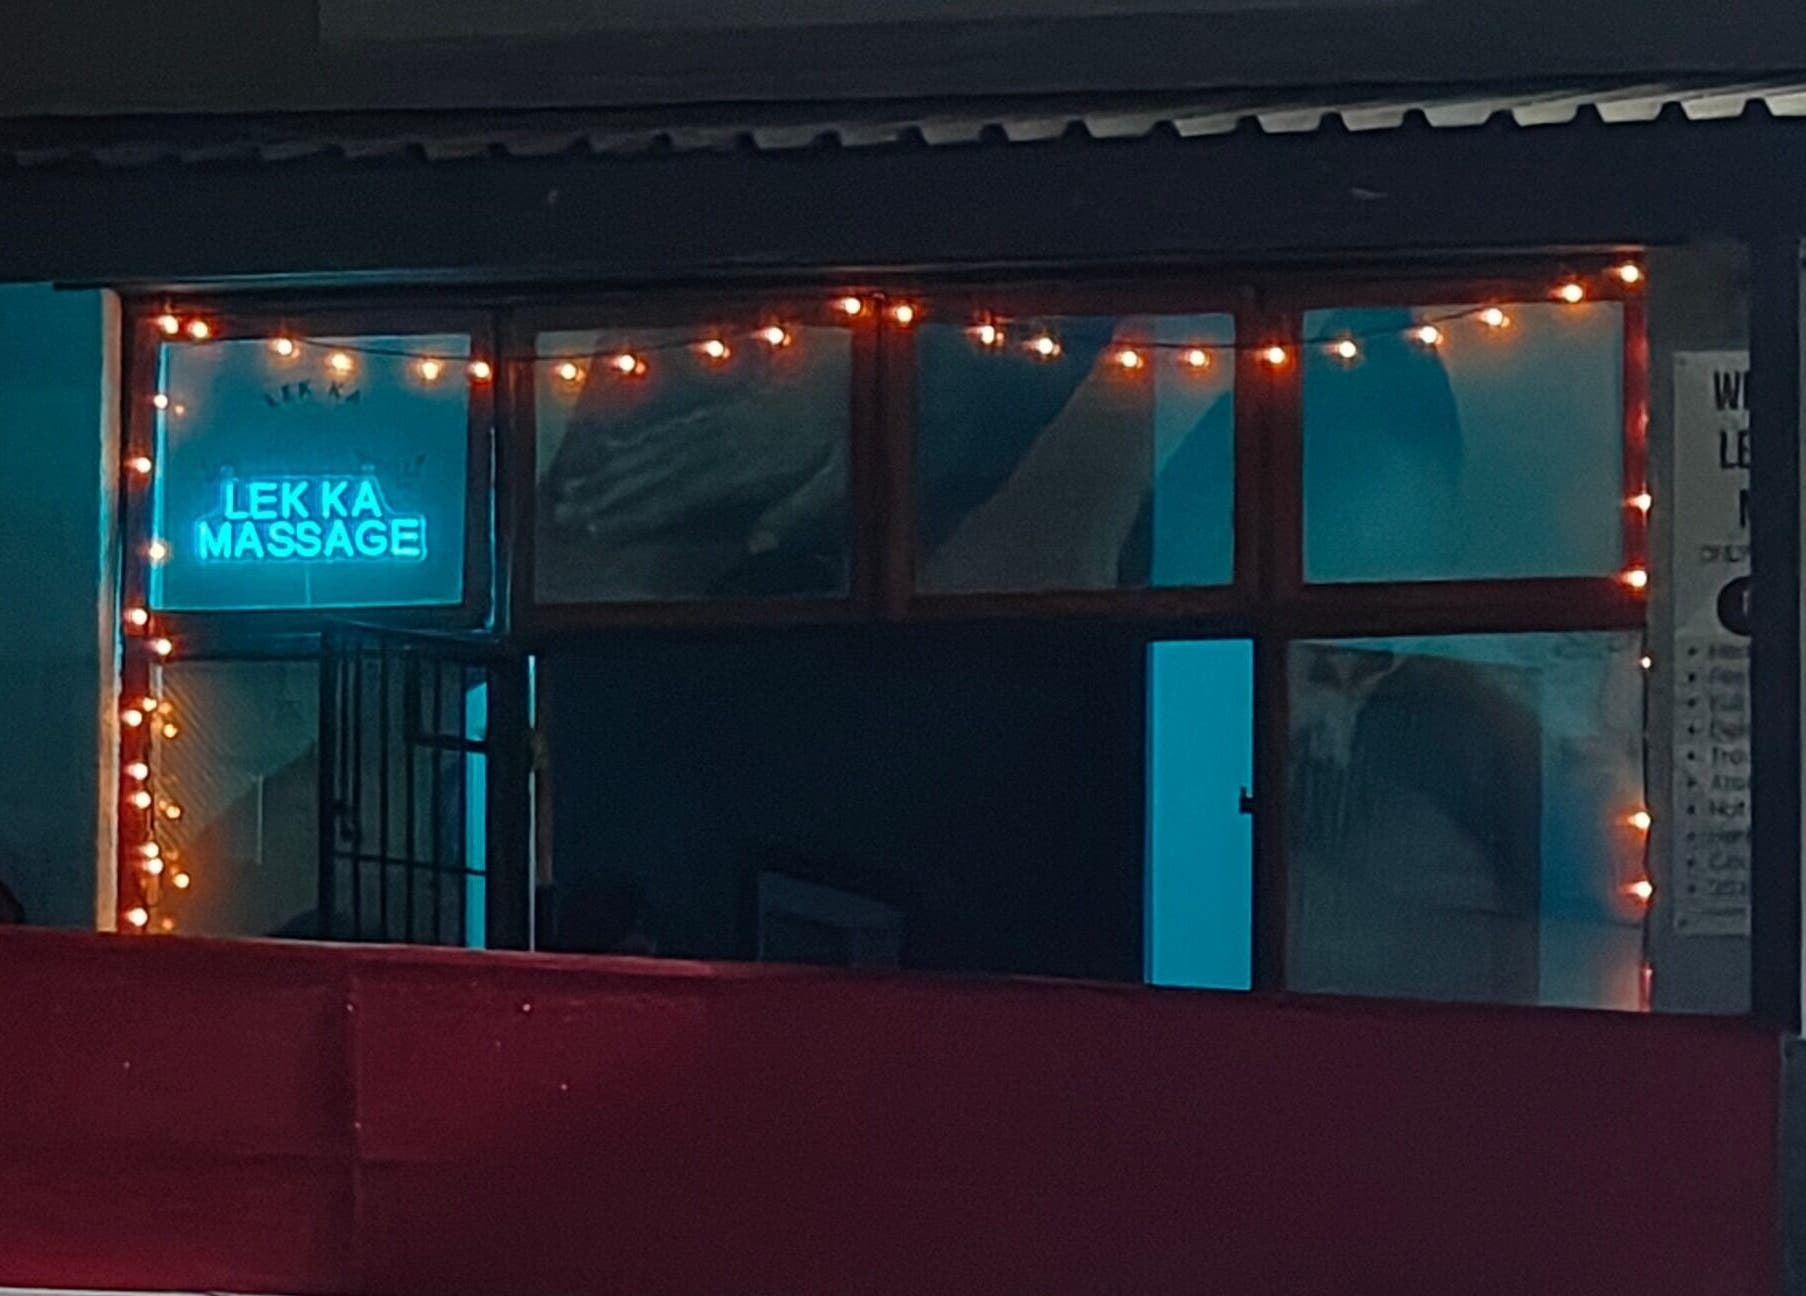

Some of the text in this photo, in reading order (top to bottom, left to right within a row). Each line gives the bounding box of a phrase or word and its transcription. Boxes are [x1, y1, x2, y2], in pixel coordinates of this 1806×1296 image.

[1719, 429, 1753, 469] LE
[224, 479, 382, 520] LEK KA
[198, 518, 421, 560] MASSAGE
